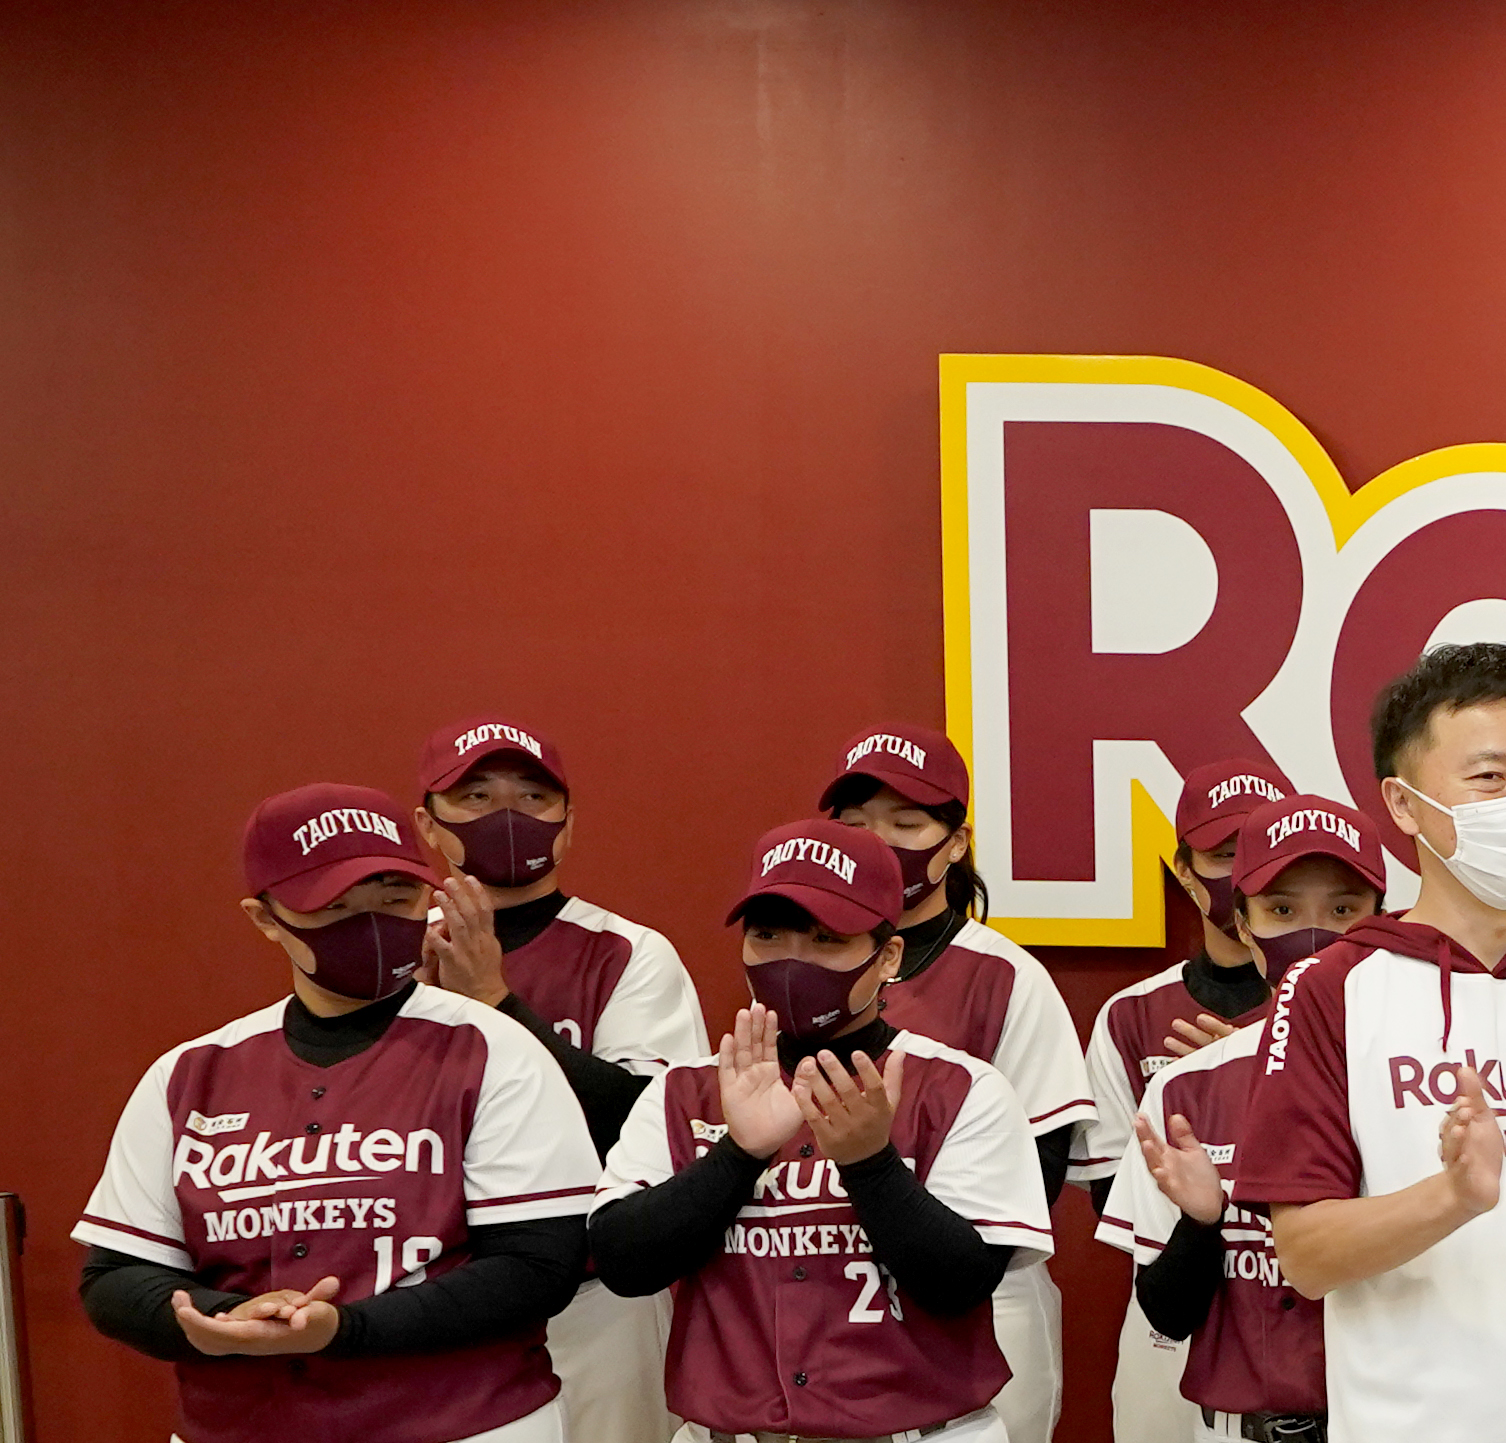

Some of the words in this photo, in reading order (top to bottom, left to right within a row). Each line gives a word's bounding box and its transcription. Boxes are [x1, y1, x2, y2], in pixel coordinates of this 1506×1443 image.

[454, 723, 543, 759] TAOYUAN
[846, 733, 926, 770] TAOYUAN
[293, 808, 402, 855] TAOYUAN
[1266, 809, 1361, 853] TAOYUAN
[761, 837, 857, 885] TAOYUAN
[1265, 957, 1321, 1075] TAOYUAN
[173, 1123, 445, 1189] Rakuten
[203, 1198, 396, 1243] MONKEYS
